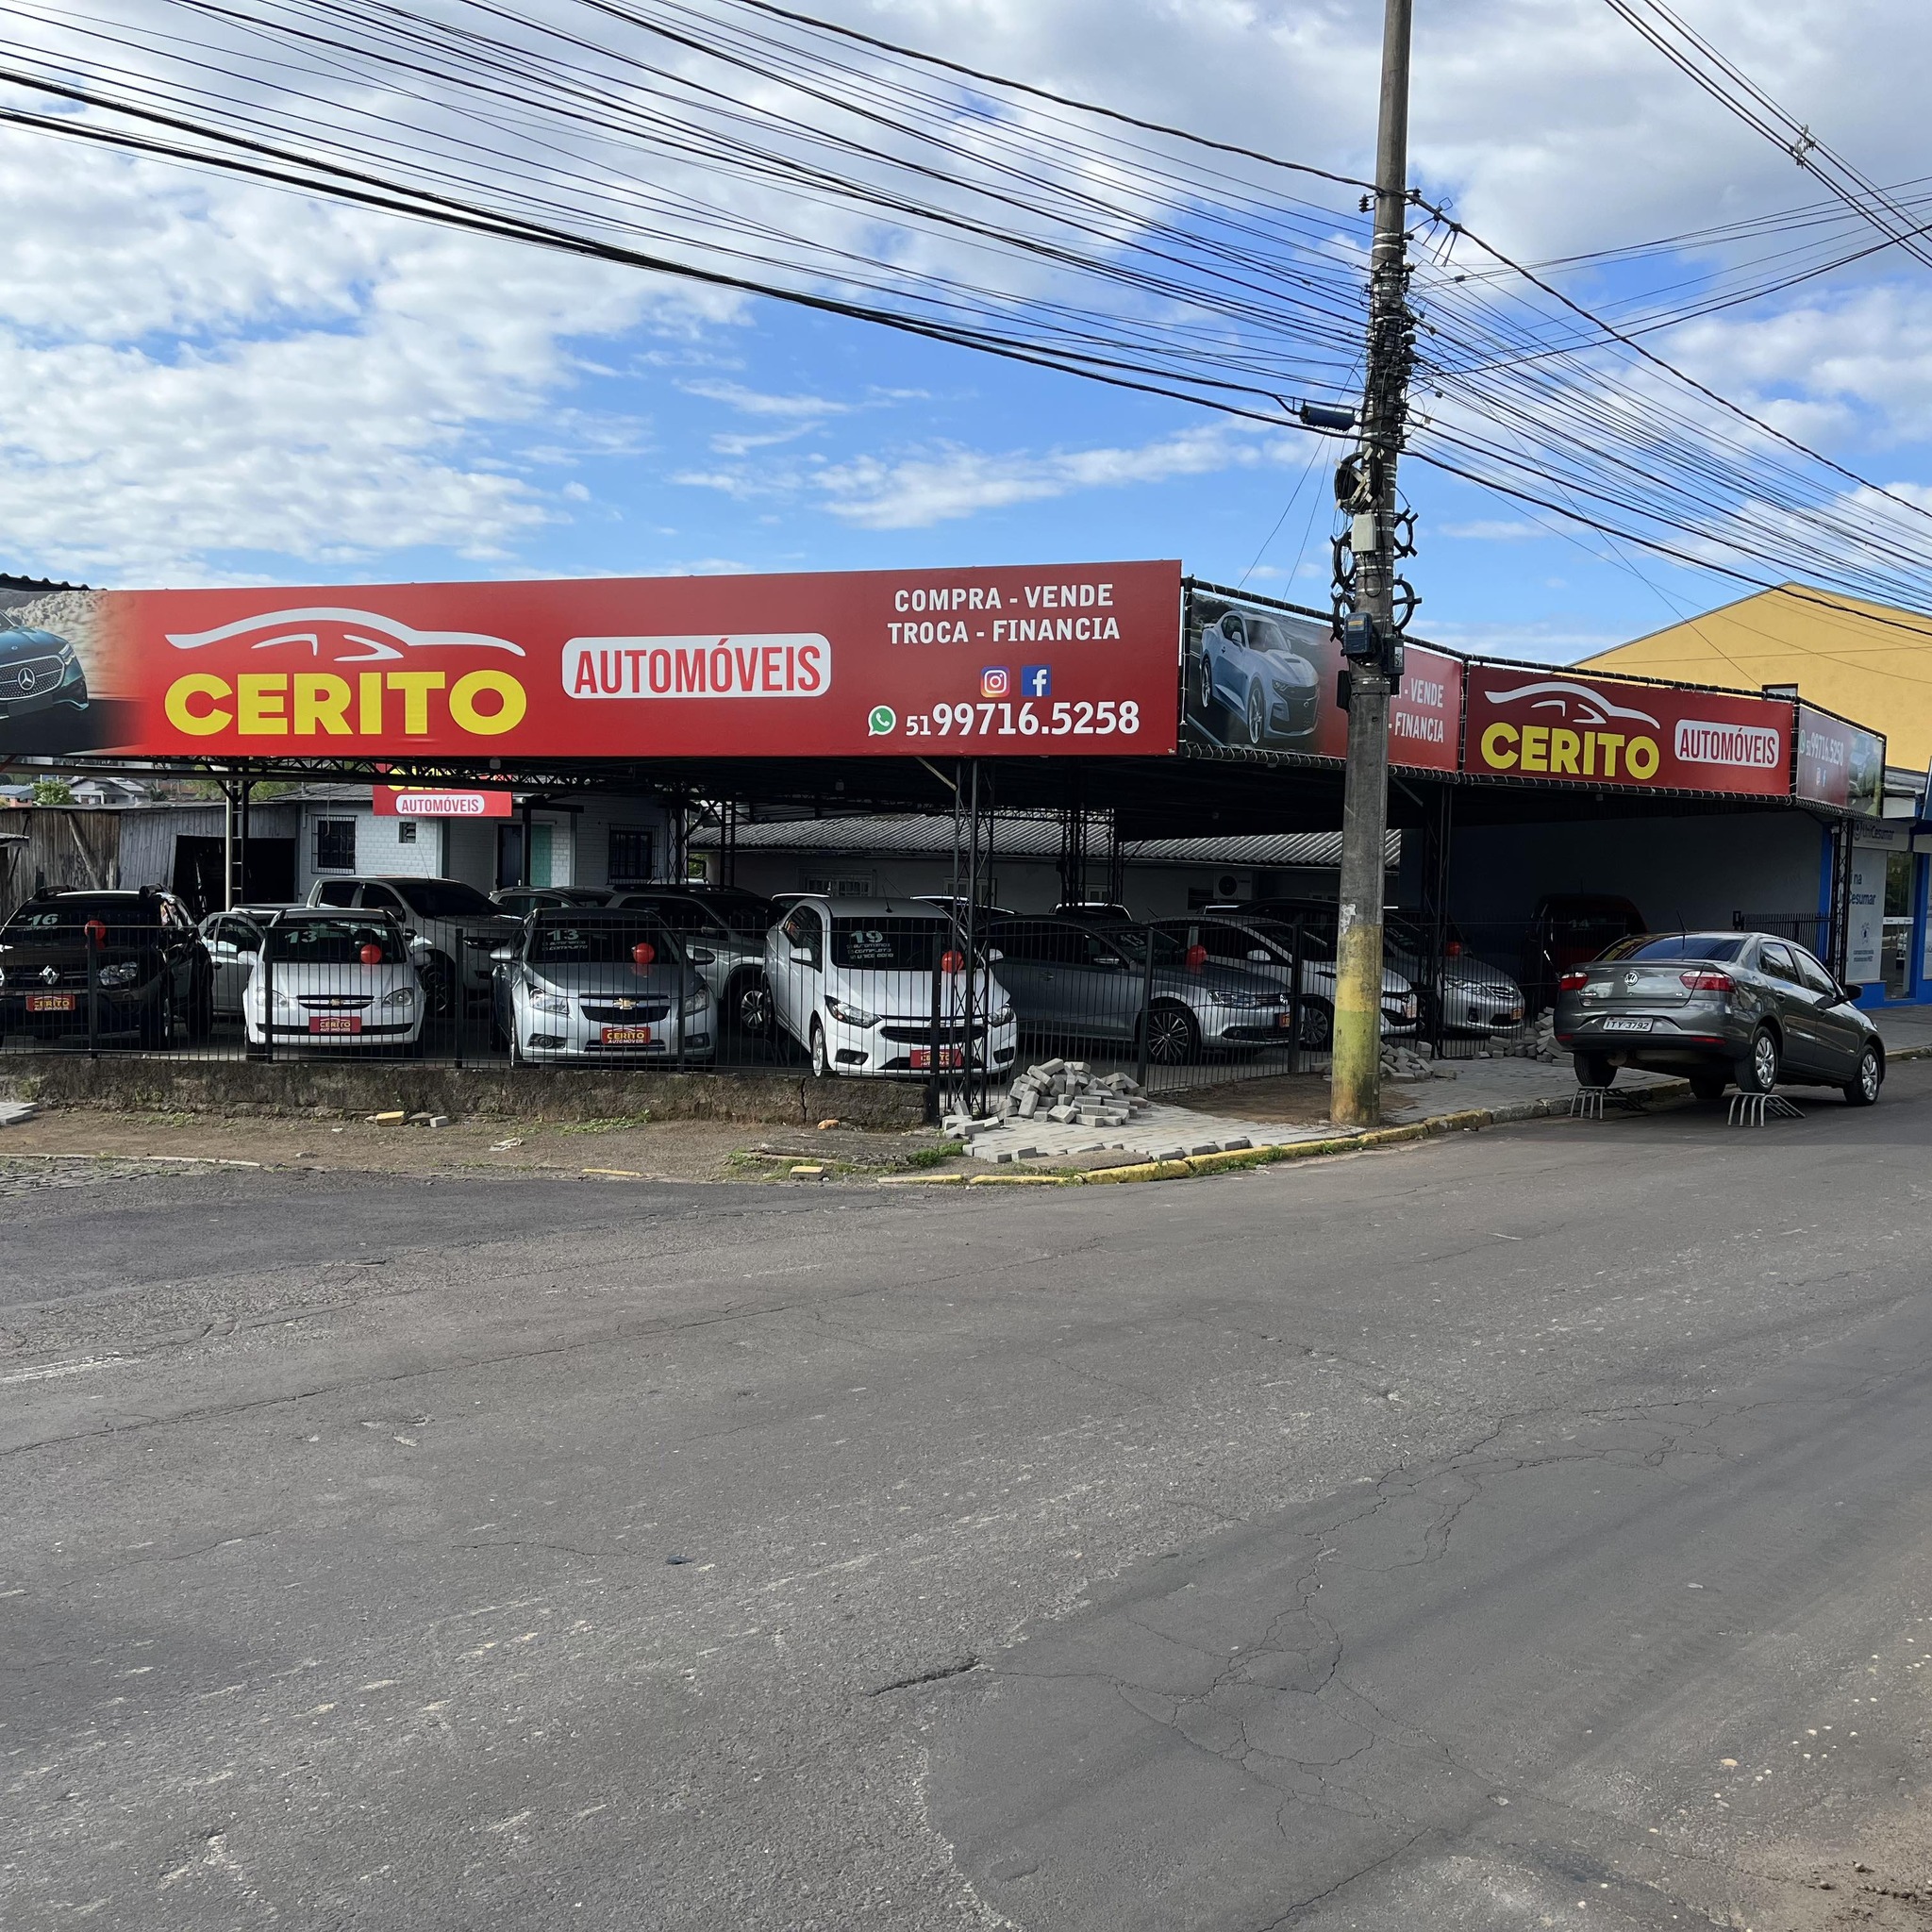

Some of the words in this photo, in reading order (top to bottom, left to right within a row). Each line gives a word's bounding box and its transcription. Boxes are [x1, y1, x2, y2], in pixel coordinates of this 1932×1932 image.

[894, 587, 1002, 612] COMPRA
[1024, 583, 1114, 608] VENDE
[887, 621, 969, 644] TROCA
[992, 617, 1121, 642] FINANCIA
[574, 638, 822, 694] AUTOMÓVEIS
[164, 669, 527, 736] CERITO
[1410, 677, 1444, 708] VENDE
[1394, 712, 1444, 742] FINANCIA
[1480, 722, 1660, 780] CERITO
[1679, 727, 1776, 764] AUTOMÓVEIS
[401, 797, 479, 812] AUTOMÓVEIS
[26, 913, 59, 926] 16
[285, 930, 318, 943] 13
[850, 930, 884, 943] 19
